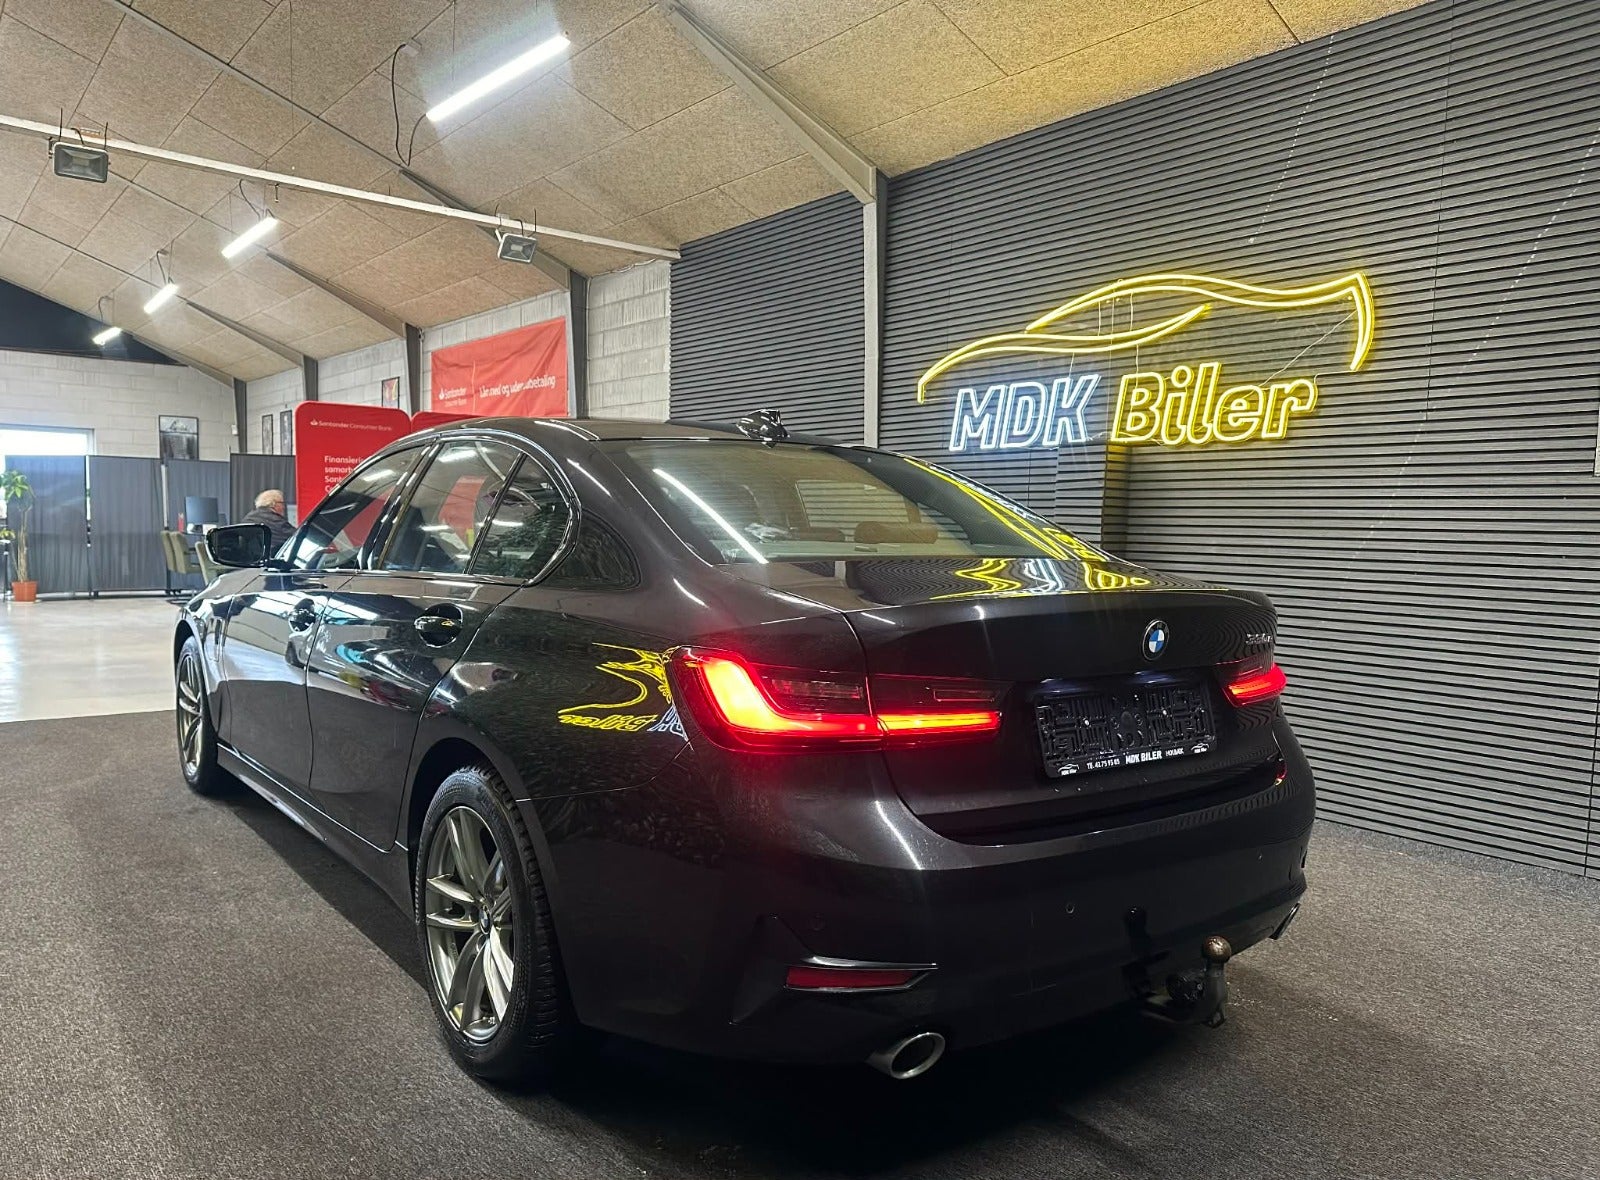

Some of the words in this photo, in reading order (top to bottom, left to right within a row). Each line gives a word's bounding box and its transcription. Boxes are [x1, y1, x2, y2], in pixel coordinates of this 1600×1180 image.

[948, 374, 1102, 452] MDK
[1110, 361, 1319, 446] Biler
[1125, 754, 1140, 764] MDK
[1140, 750, 1163, 762] BILER
